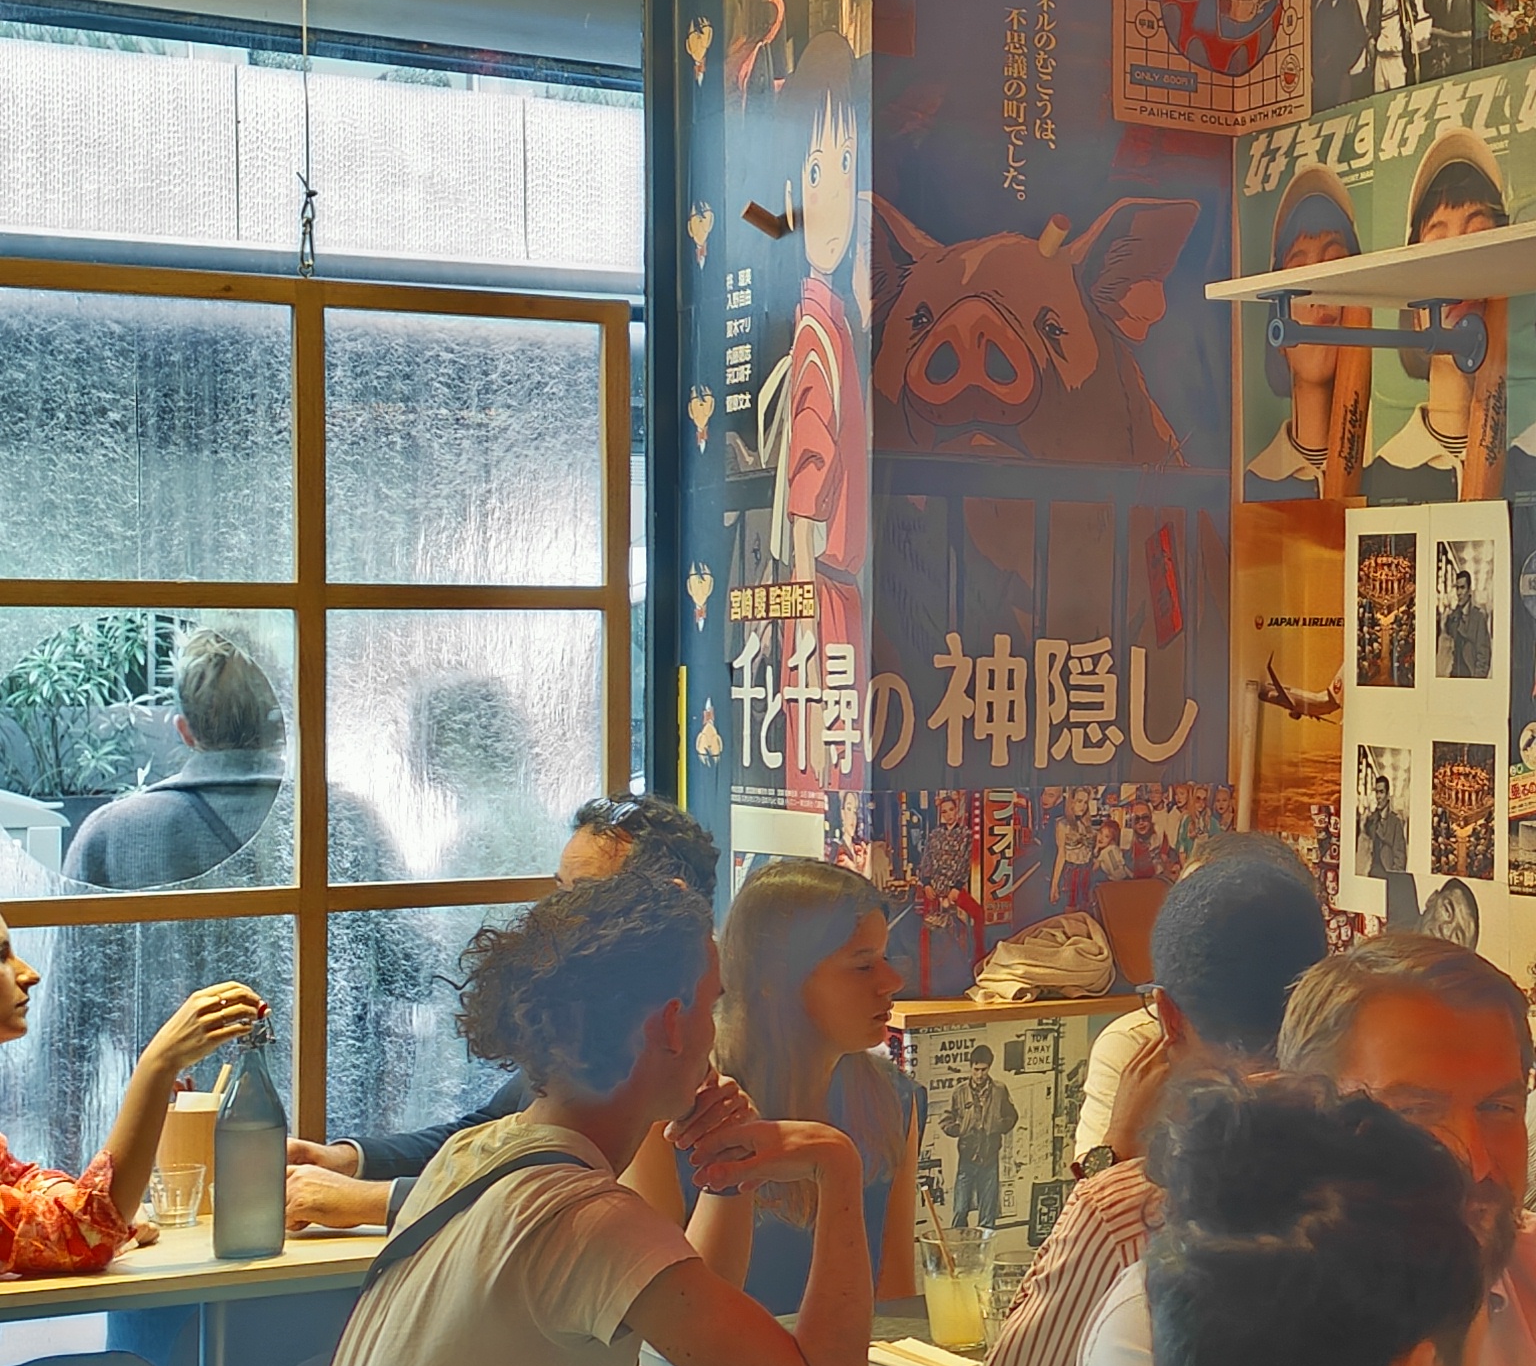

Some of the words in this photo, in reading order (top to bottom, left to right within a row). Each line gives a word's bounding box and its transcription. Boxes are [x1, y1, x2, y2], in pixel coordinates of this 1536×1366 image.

[1002, 6, 1028, 201] 不思議の町でした。
[1138, 105, 1195, 123] PAIHEME
[1200, 112, 1247, 127] COLLAB
[1267, 616, 1301, 628] JAPAN
[1302, 616, 1345, 628] AIRLINE
[730, 629, 1200, 774] 千と千尋の神隠し
[939, 1037, 976, 1052] ADULT
[1026, 1043, 1052, 1055] AWAY
[934, 1052, 971, 1065] MOVIE
[1026, 1055, 1052, 1067] ZONE
